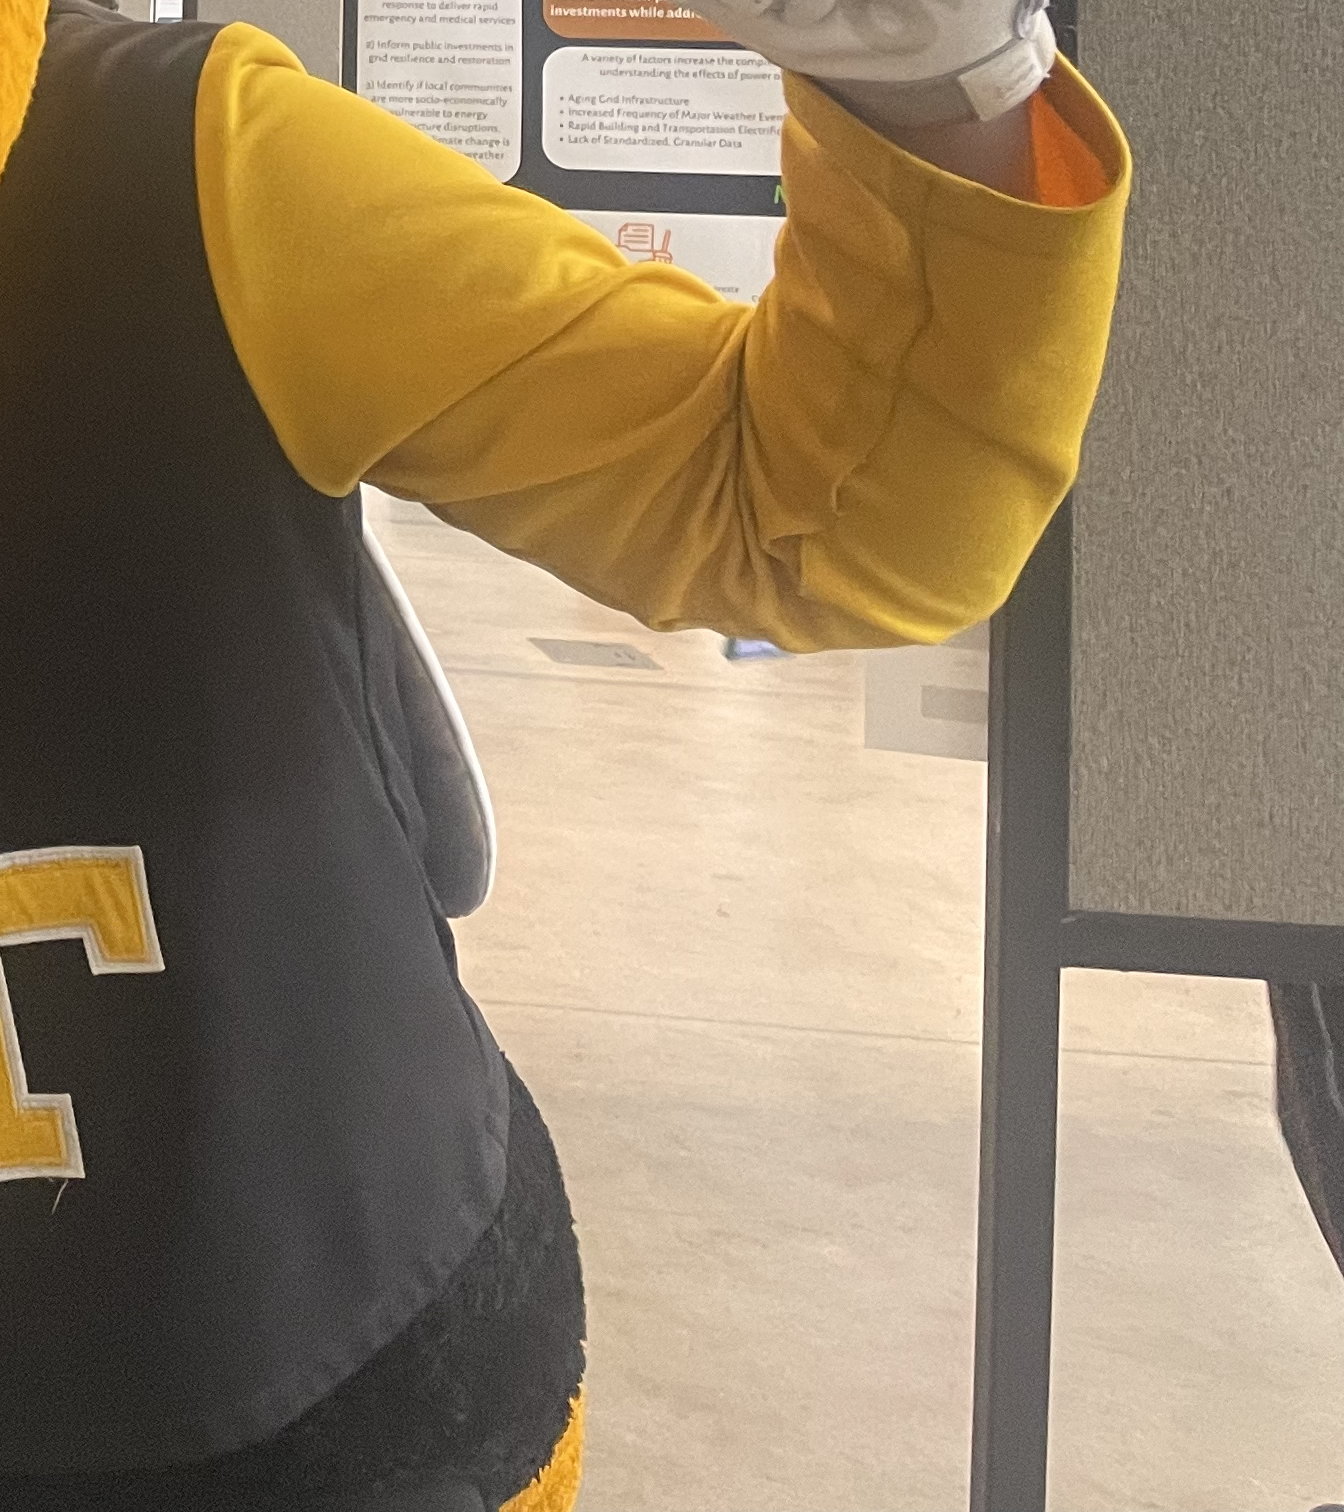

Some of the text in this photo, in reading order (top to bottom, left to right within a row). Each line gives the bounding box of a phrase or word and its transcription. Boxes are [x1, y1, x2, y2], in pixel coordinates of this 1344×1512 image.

[382, 2, 424, 10] response
[439, 1, 470, 10] deliver
[550, 5, 627, 17] Investments
[629, 7, 664, 18] while
[364, 14, 516, 25] emergency and medical services
[377, 40, 410, 49] Inform
[413, 40, 442, 51] public
[444, 42, 502, 51] investments
[504, 44, 513, 52] in
[438, 55, 456, 64] and
[458, 56, 511, 65] restoration
[582, 54, 589, 62] A
[626, 54, 636, 63] of
[639, 55, 671, 64] factors
[674, 56, 715, 65] increase
[717, 56, 733, 65] the
[600, 69, 671, 79] understanding
[674, 70, 690, 79] the
[693, 70, 725, 79] effects
[727, 70, 739, 80] of
[741, 72, 771, 81] power
[377, 80, 414, 91] Identify
[417, 81, 424, 90] if
[425, 81, 448, 91] local
[371, 95, 386, 103] are
[569, 94, 597, 105] Aging
[622, 95, 689, 106] Infrastructure
[443, 110, 452, 118] to
[455, 111, 488, 120] energy
[569, 108, 614, 117] Increased
[617, 108, 667, 120] Frequency
[669, 109, 679, 120] of
[681, 110, 711, 121] Major
[712, 112, 756, 120] Weather
[569, 121, 596, 131] Rapid
[599, 121, 639, 133] Building
[641, 123, 660, 132] and
[465, 137, 500, 148] change
[502, 137, 510, 147] is
[568, 135, 589, 144] Lack
[592, 134, 601, 144] of
[719, 139, 742, 148] Data
